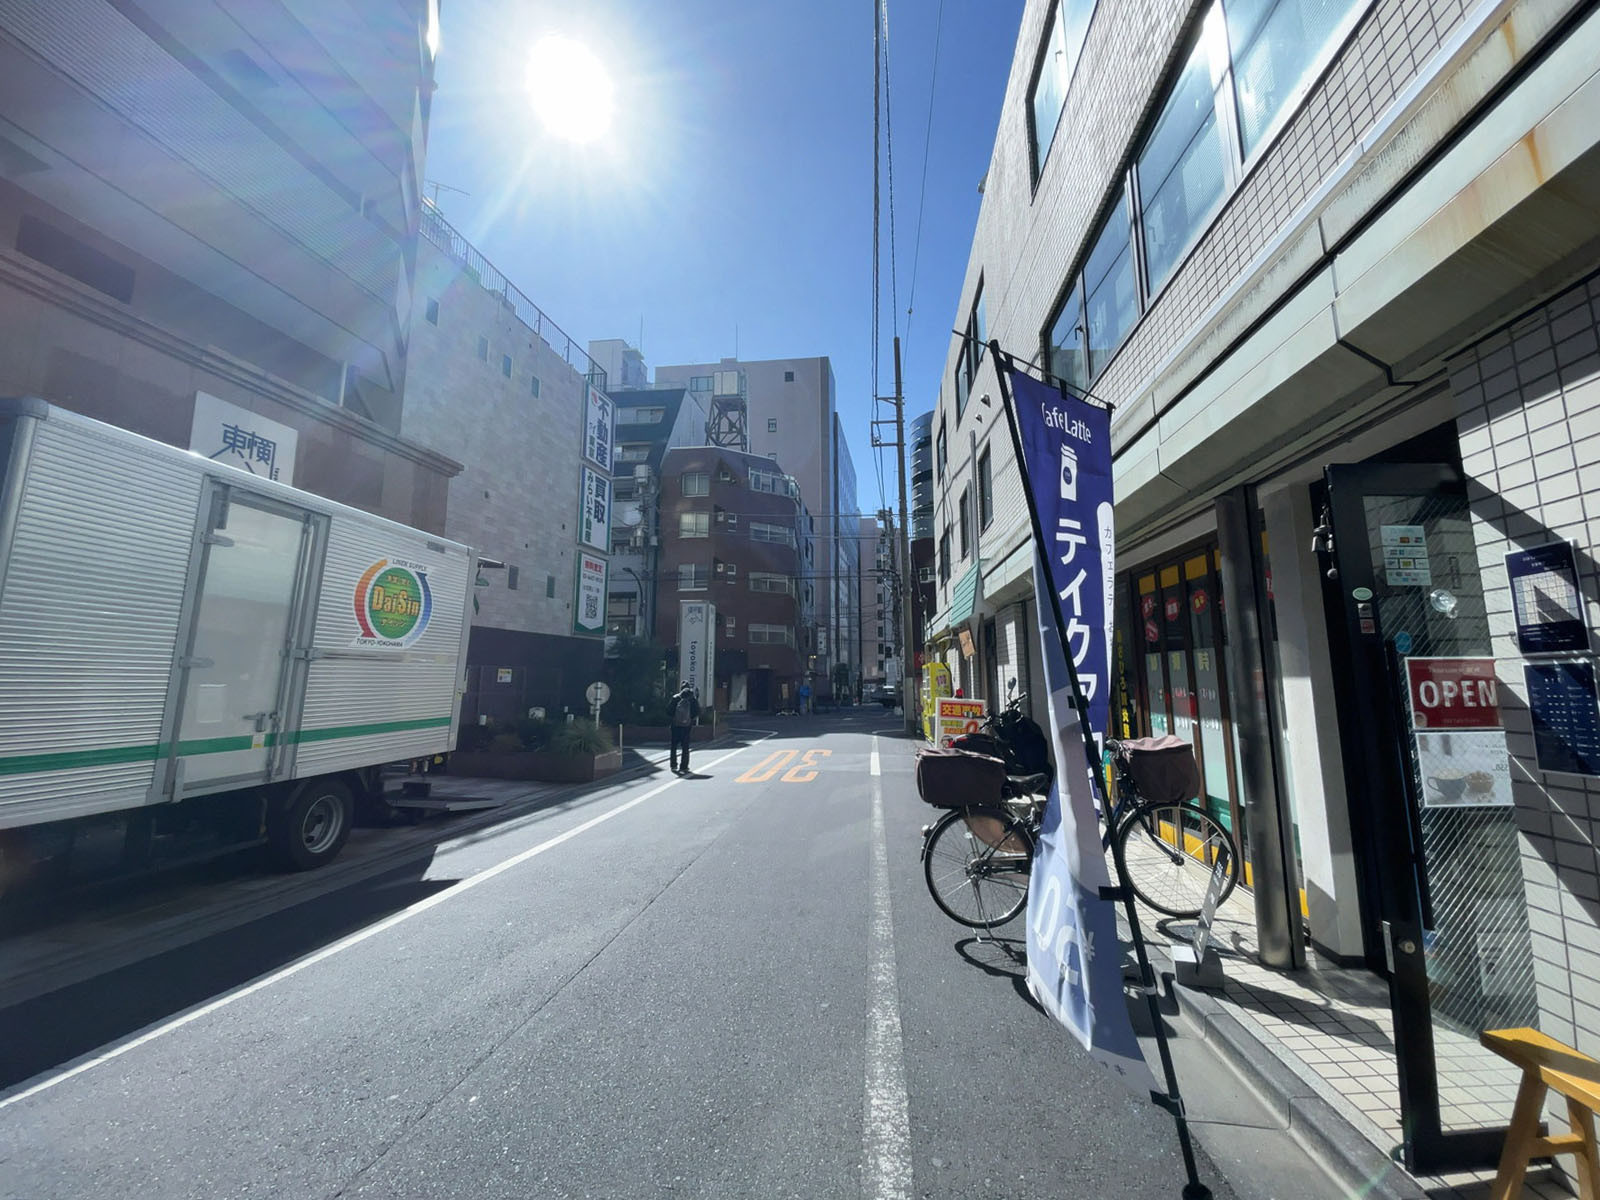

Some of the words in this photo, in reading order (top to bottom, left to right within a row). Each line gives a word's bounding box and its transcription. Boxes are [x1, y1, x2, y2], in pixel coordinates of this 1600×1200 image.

[596, 395, 610, 468] 不動産
[594, 475, 607, 524] 買取
[372, 585, 420, 617] DaiSin
[689, 640, 699, 672] toyoko
[1419, 679, 1499, 708] OPEN
[732, 749, 833, 784] 30
